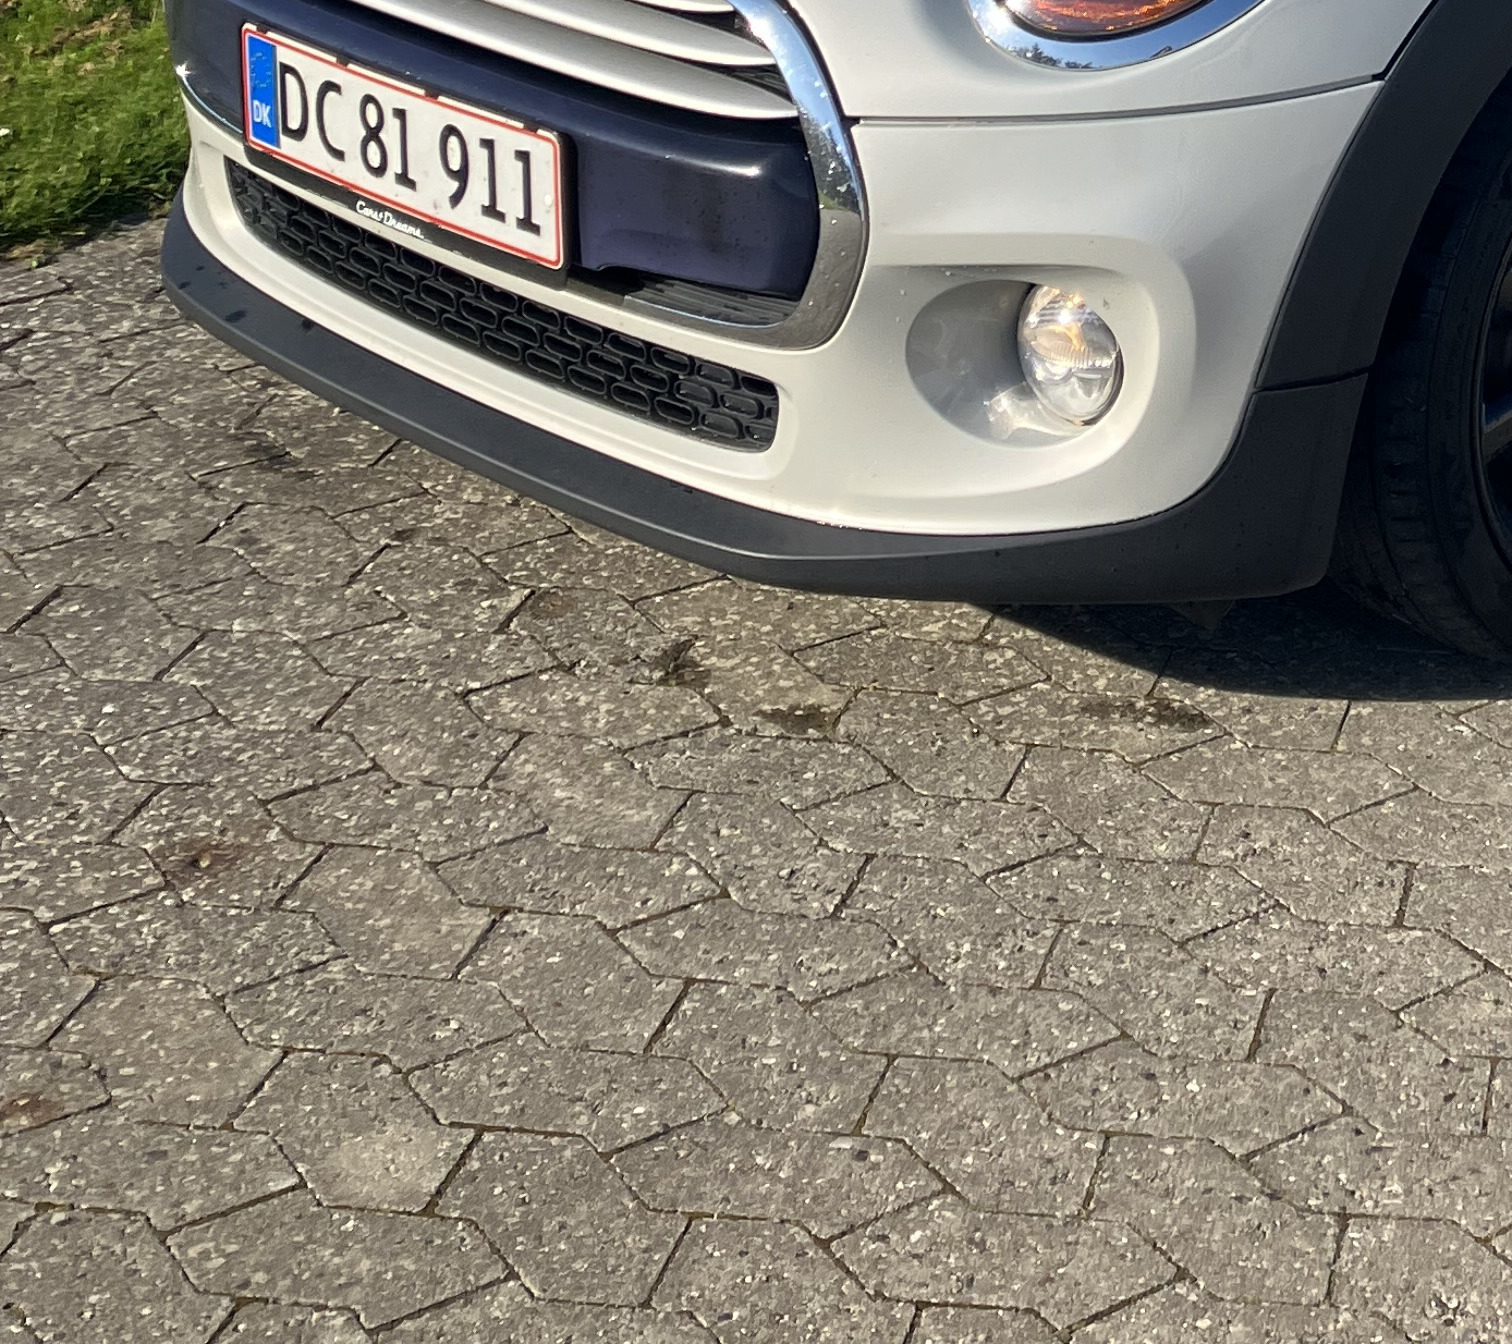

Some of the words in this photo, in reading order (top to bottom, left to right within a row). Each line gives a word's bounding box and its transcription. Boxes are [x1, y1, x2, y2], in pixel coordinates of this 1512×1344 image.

[253, 99, 271, 128] DK
[279, 61, 345, 162] DC
[359, 93, 417, 192] 81
[439, 123, 541, 236] 911
